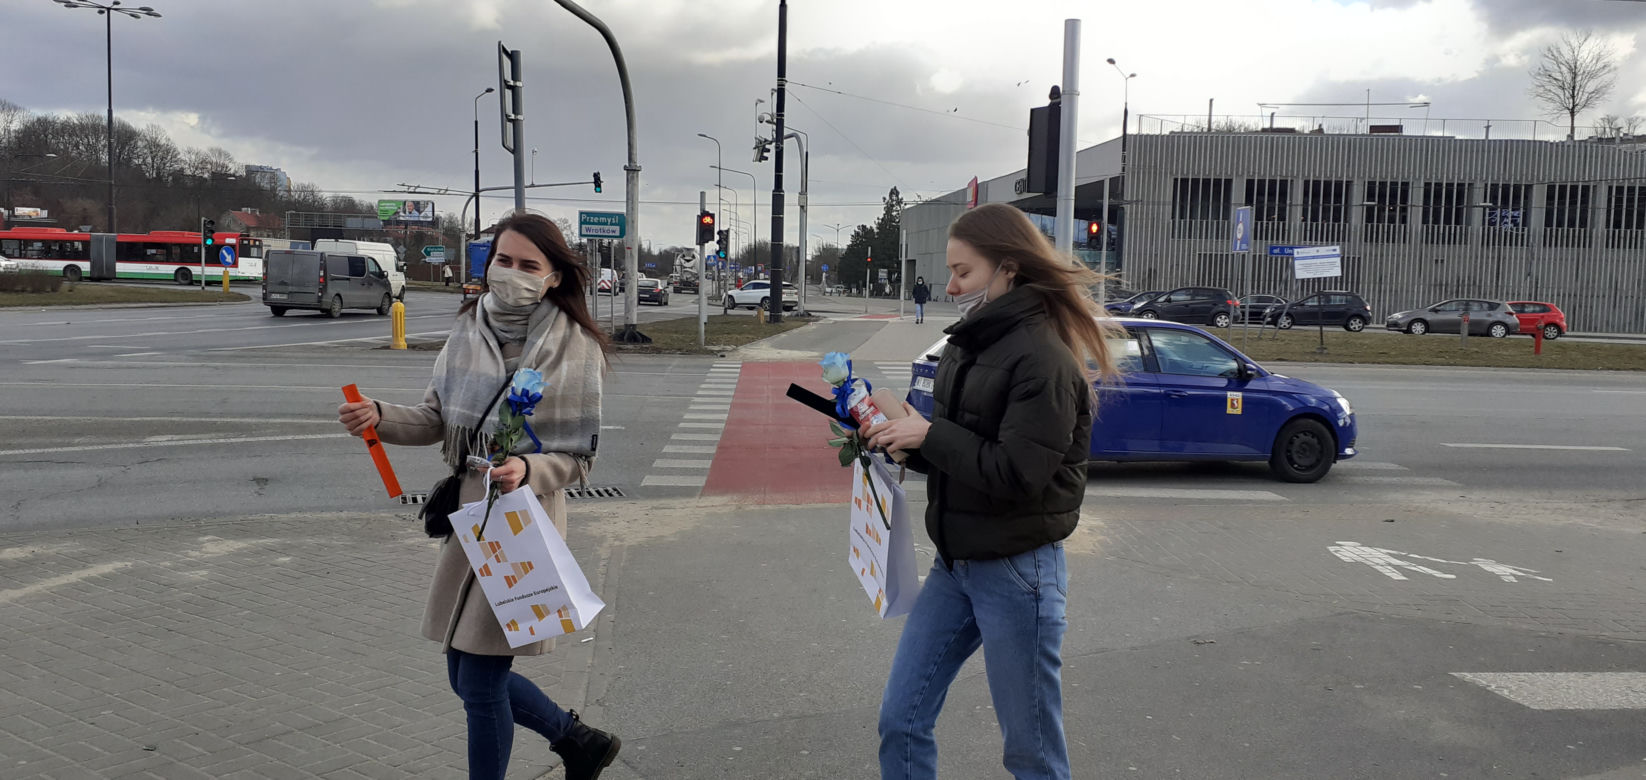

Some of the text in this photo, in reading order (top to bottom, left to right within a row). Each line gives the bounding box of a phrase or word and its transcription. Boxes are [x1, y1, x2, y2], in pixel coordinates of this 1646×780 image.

[581, 213, 619, 225] Przemyśl
[495, 585, 558, 607] Lubelskie Fundusze Europejskie
